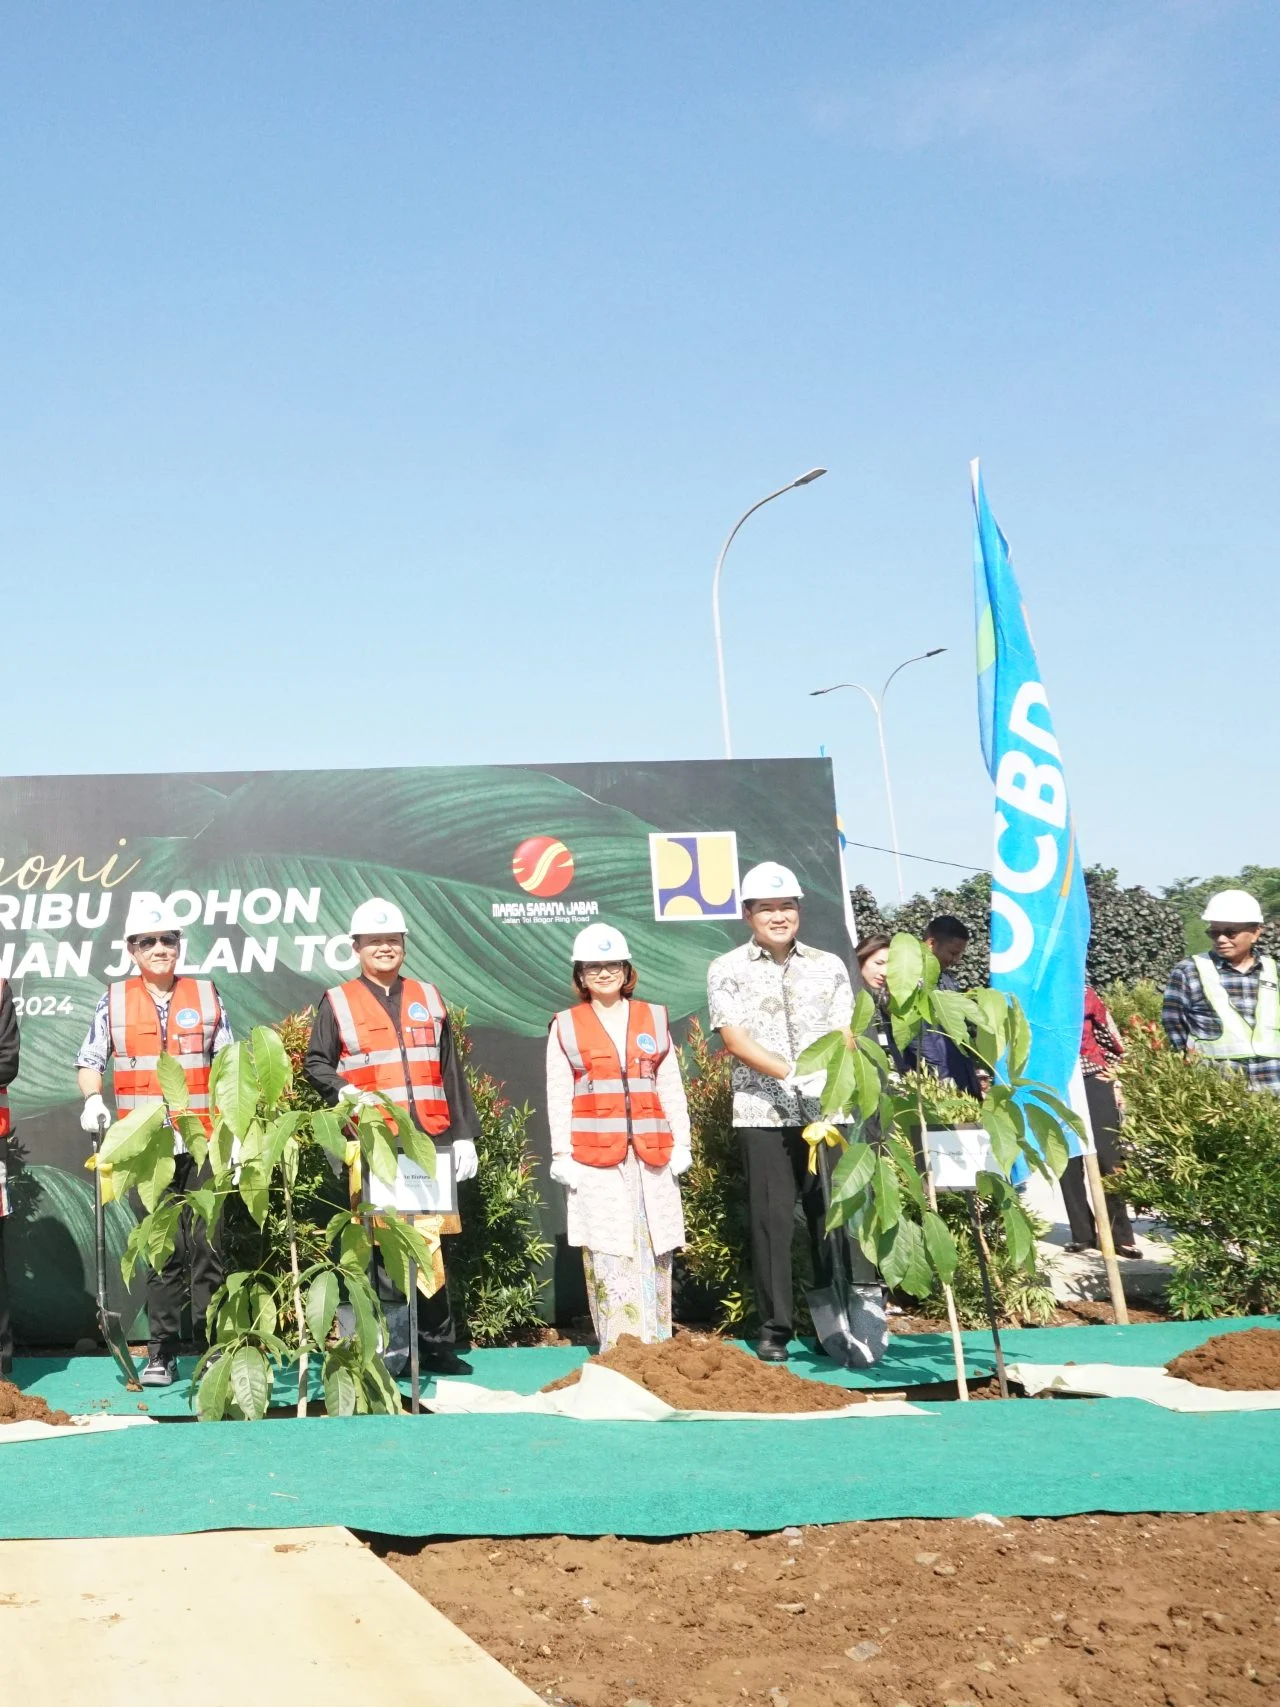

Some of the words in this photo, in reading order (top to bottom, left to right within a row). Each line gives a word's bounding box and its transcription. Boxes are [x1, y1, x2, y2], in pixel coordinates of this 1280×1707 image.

[566, 901, 599, 915] JABAR
[555, 916, 570, 924] Ring
[104, 936, 279, 977] JLAN
[14, 996, 74, 1016] 2024
